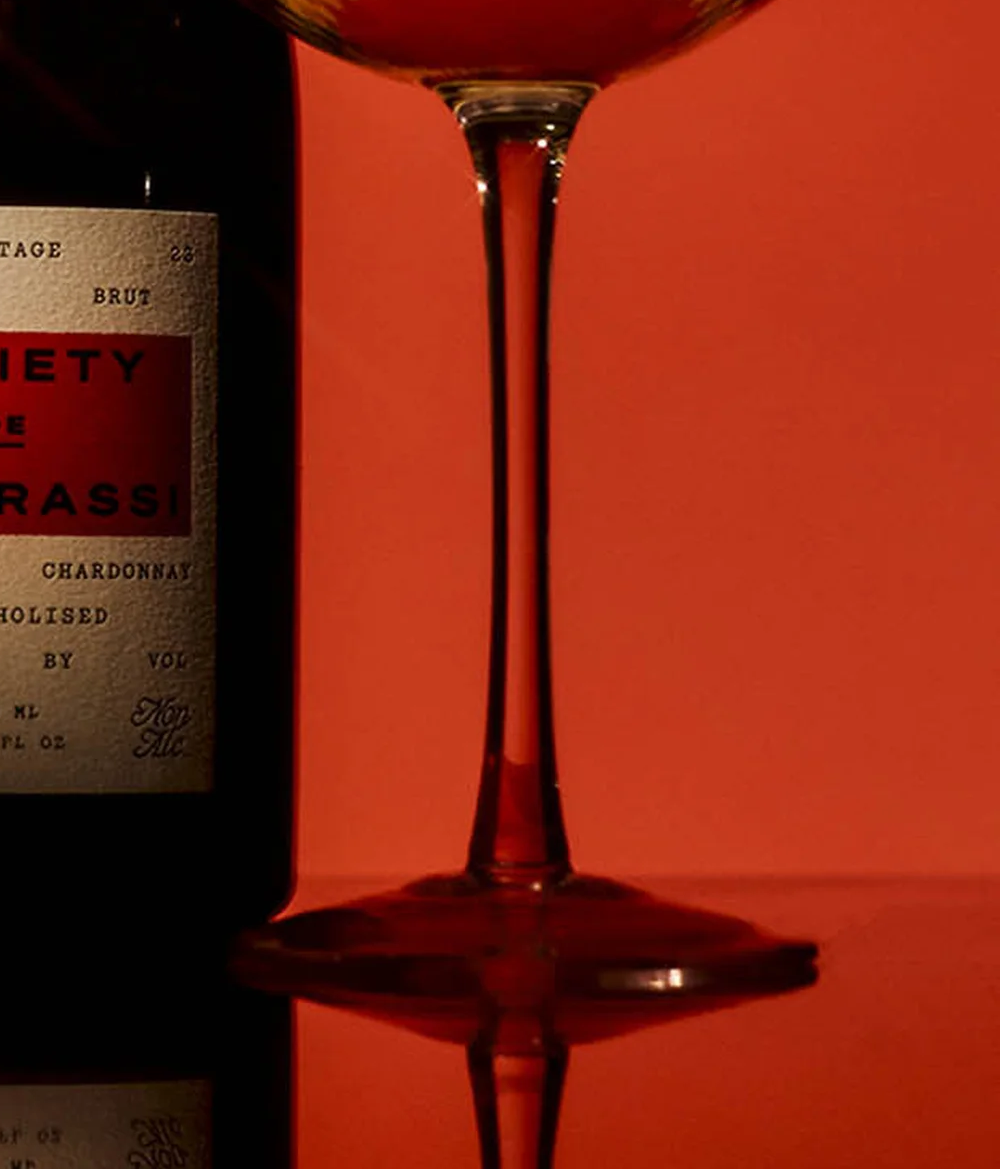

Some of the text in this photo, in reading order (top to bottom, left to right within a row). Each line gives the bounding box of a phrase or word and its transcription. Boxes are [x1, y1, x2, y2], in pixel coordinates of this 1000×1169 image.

[93, 287, 150, 306] BRUT
[41, 562, 193, 580] CHARDONNAY
[43, 652, 73, 670] BY
[147, 651, 187, 669] VOL
[14, 705, 40, 719] ML
[1, 735, 26, 750] FL
[40, 735, 66, 750] OZ
[131, 725, 185, 761] Alc
